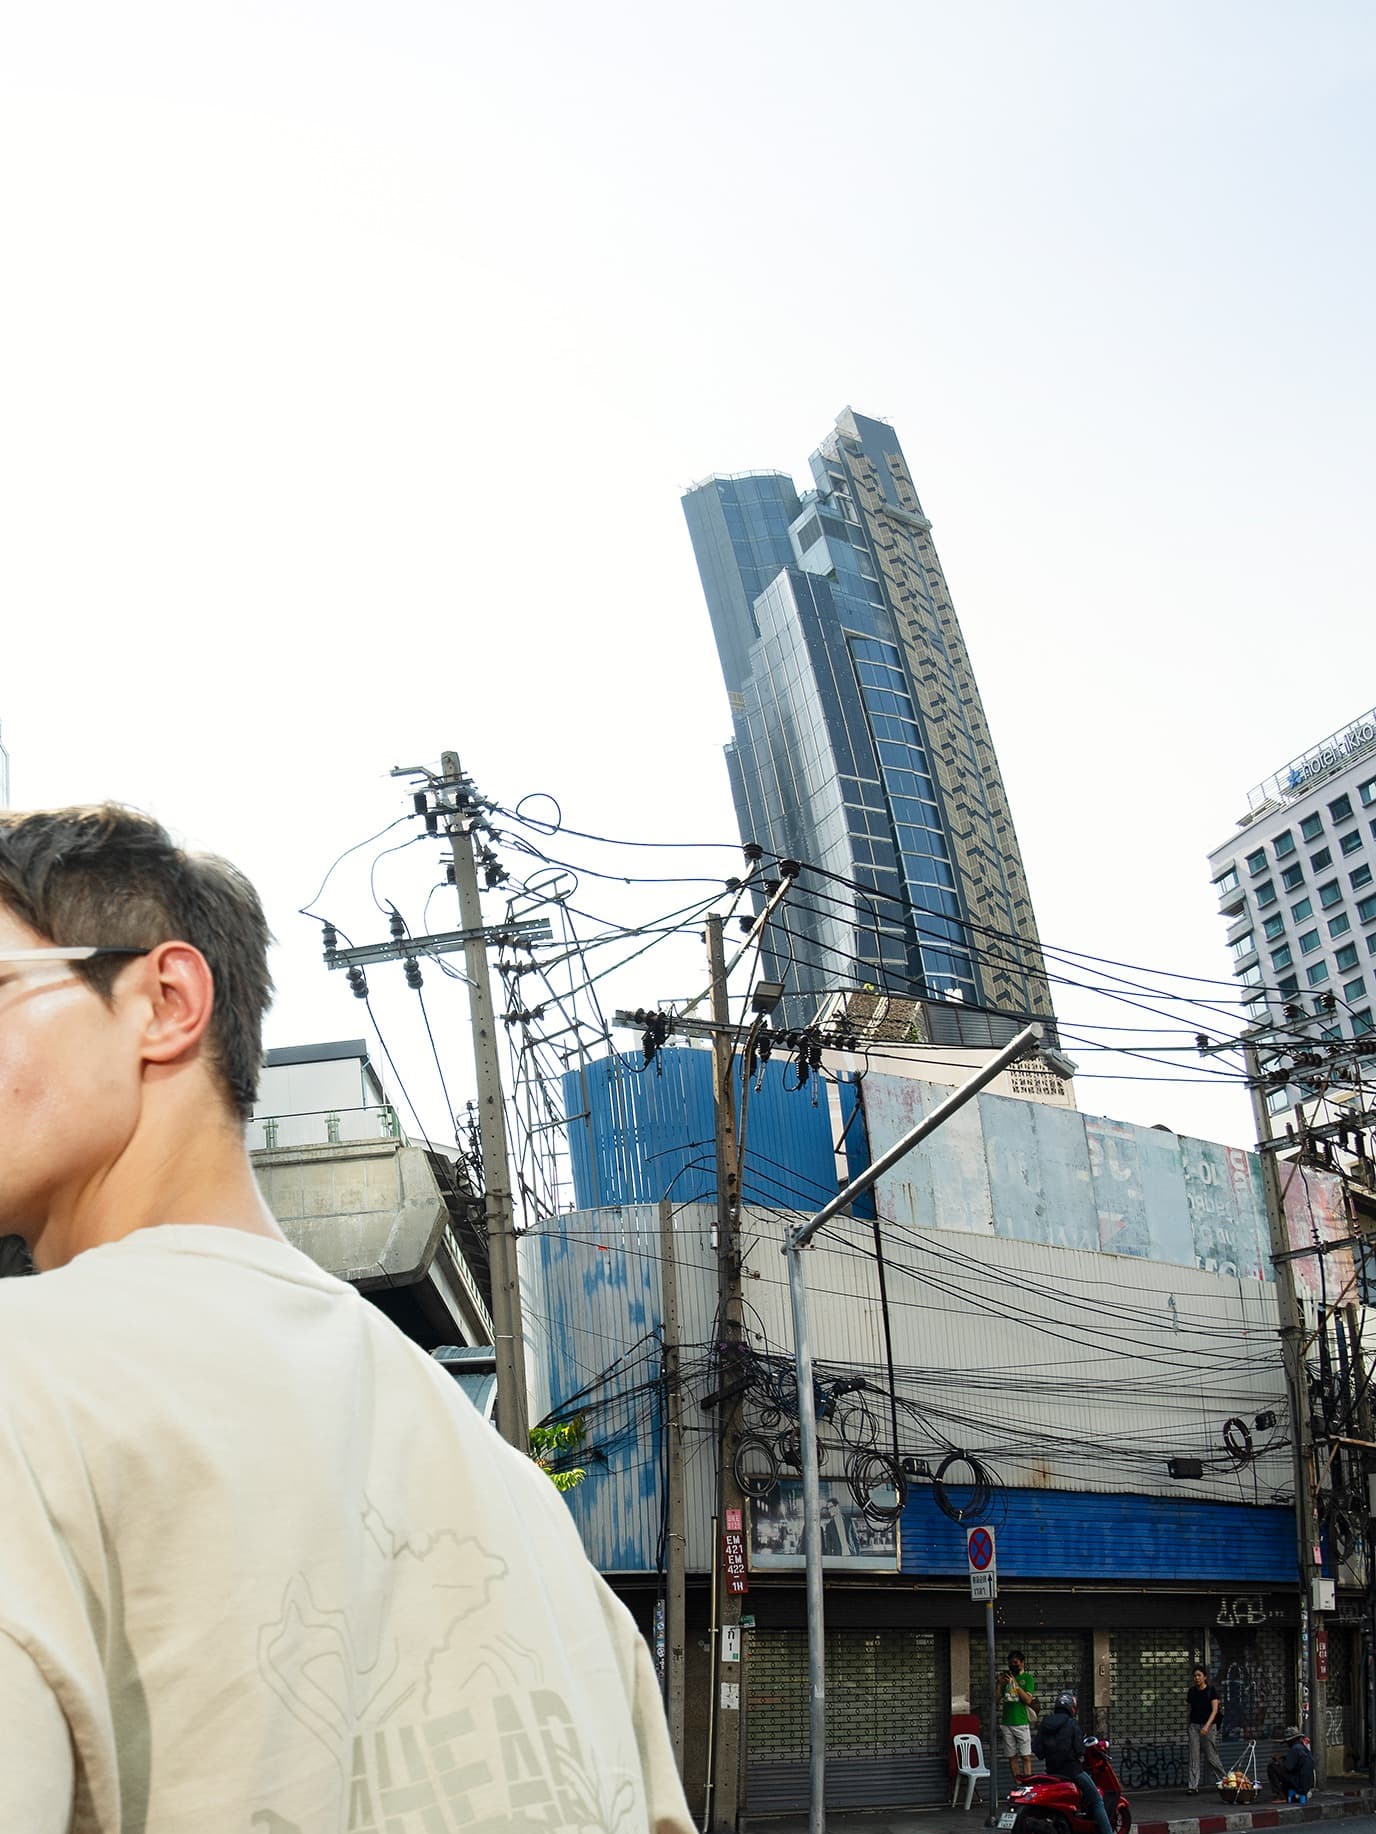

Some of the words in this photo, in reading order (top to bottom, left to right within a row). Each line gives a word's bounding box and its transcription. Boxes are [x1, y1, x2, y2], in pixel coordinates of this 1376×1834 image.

[1302, 742, 1337, 780] hotel
[726, 1535, 741, 1545] EM
[725, 1545, 744, 1554] 421
[728, 1555, 743, 1565] EM
[727, 1565, 745, 1575] 422
